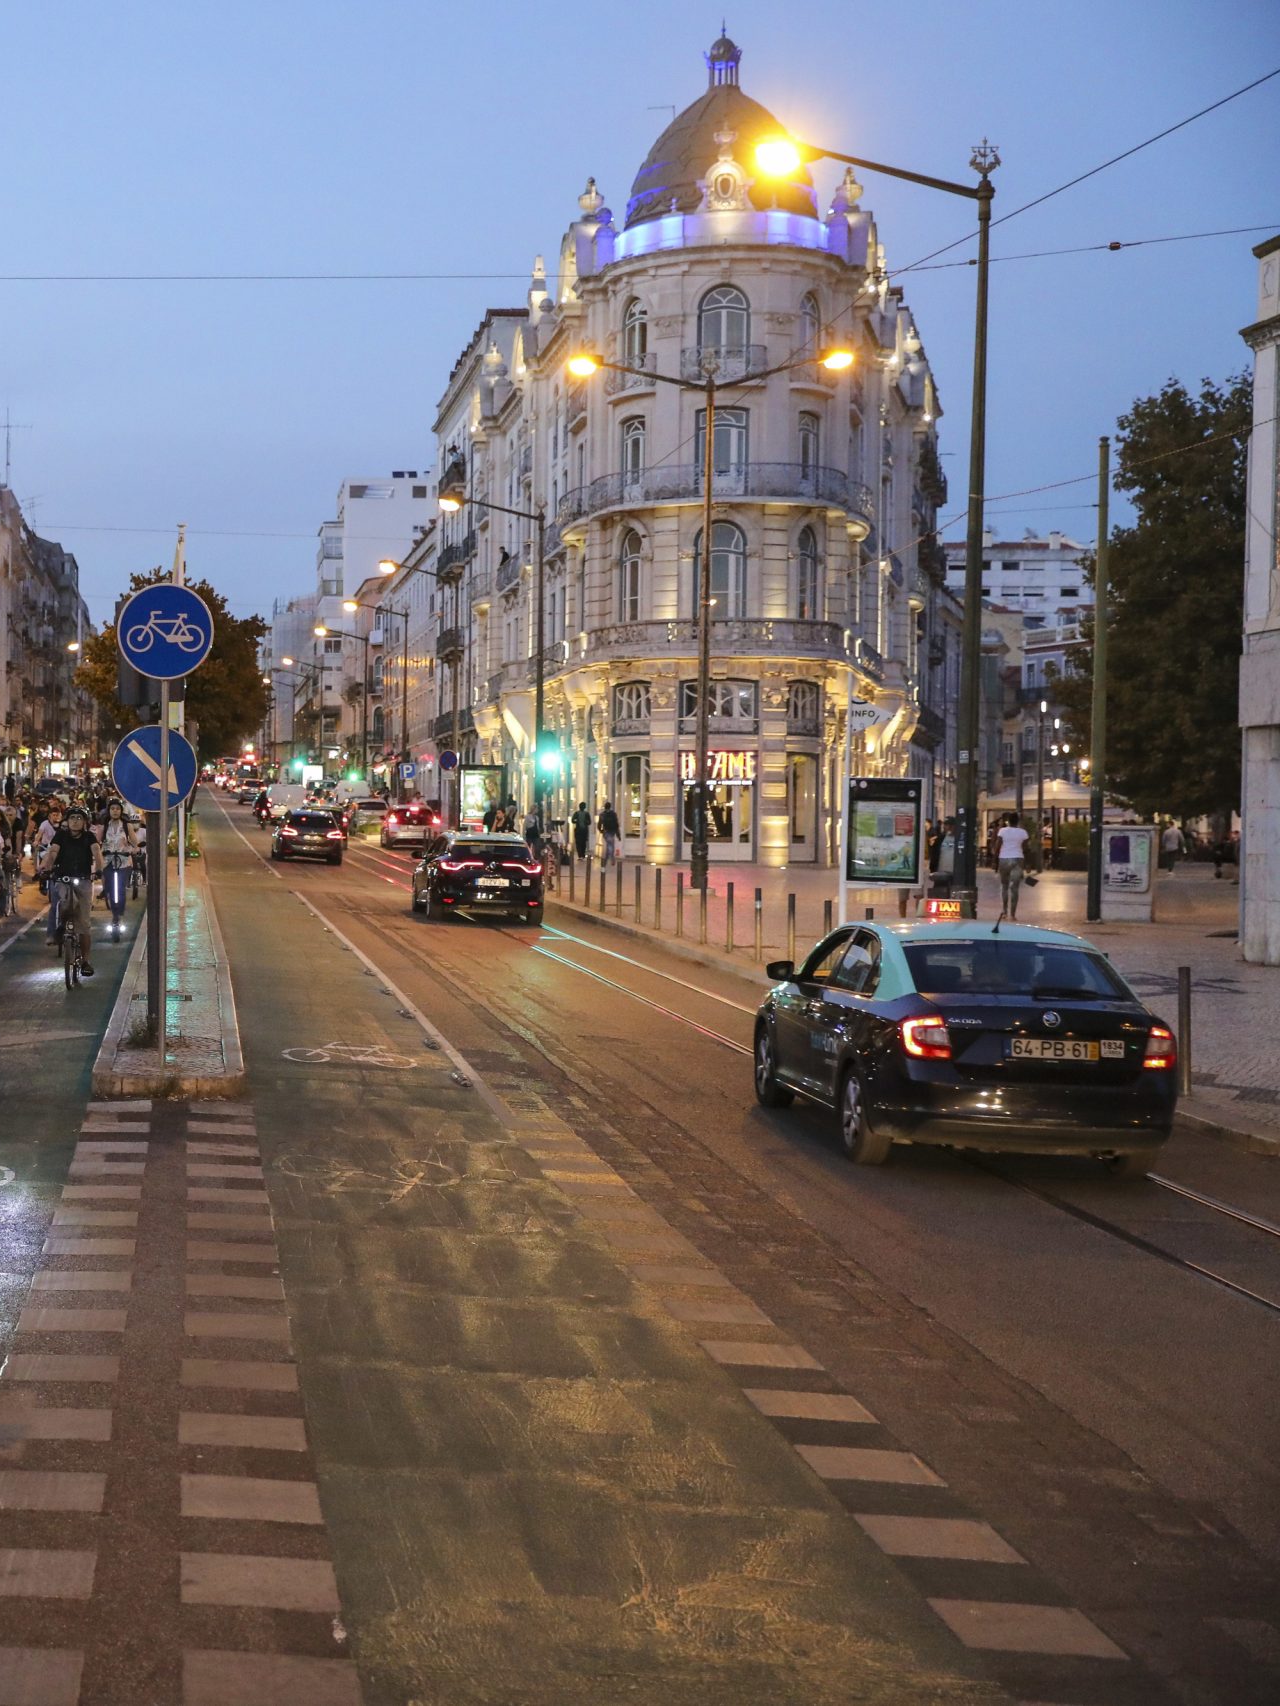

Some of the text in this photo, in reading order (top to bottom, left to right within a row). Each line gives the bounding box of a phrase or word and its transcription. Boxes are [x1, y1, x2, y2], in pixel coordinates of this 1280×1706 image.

[851, 709, 876, 717] INFO
[403, 765, 413, 778] P
[939, 901, 960, 912] TAXI
[1013, 1040, 1089, 1059] 64-PB-61
[1103, 1041, 1123, 1051] 1834
